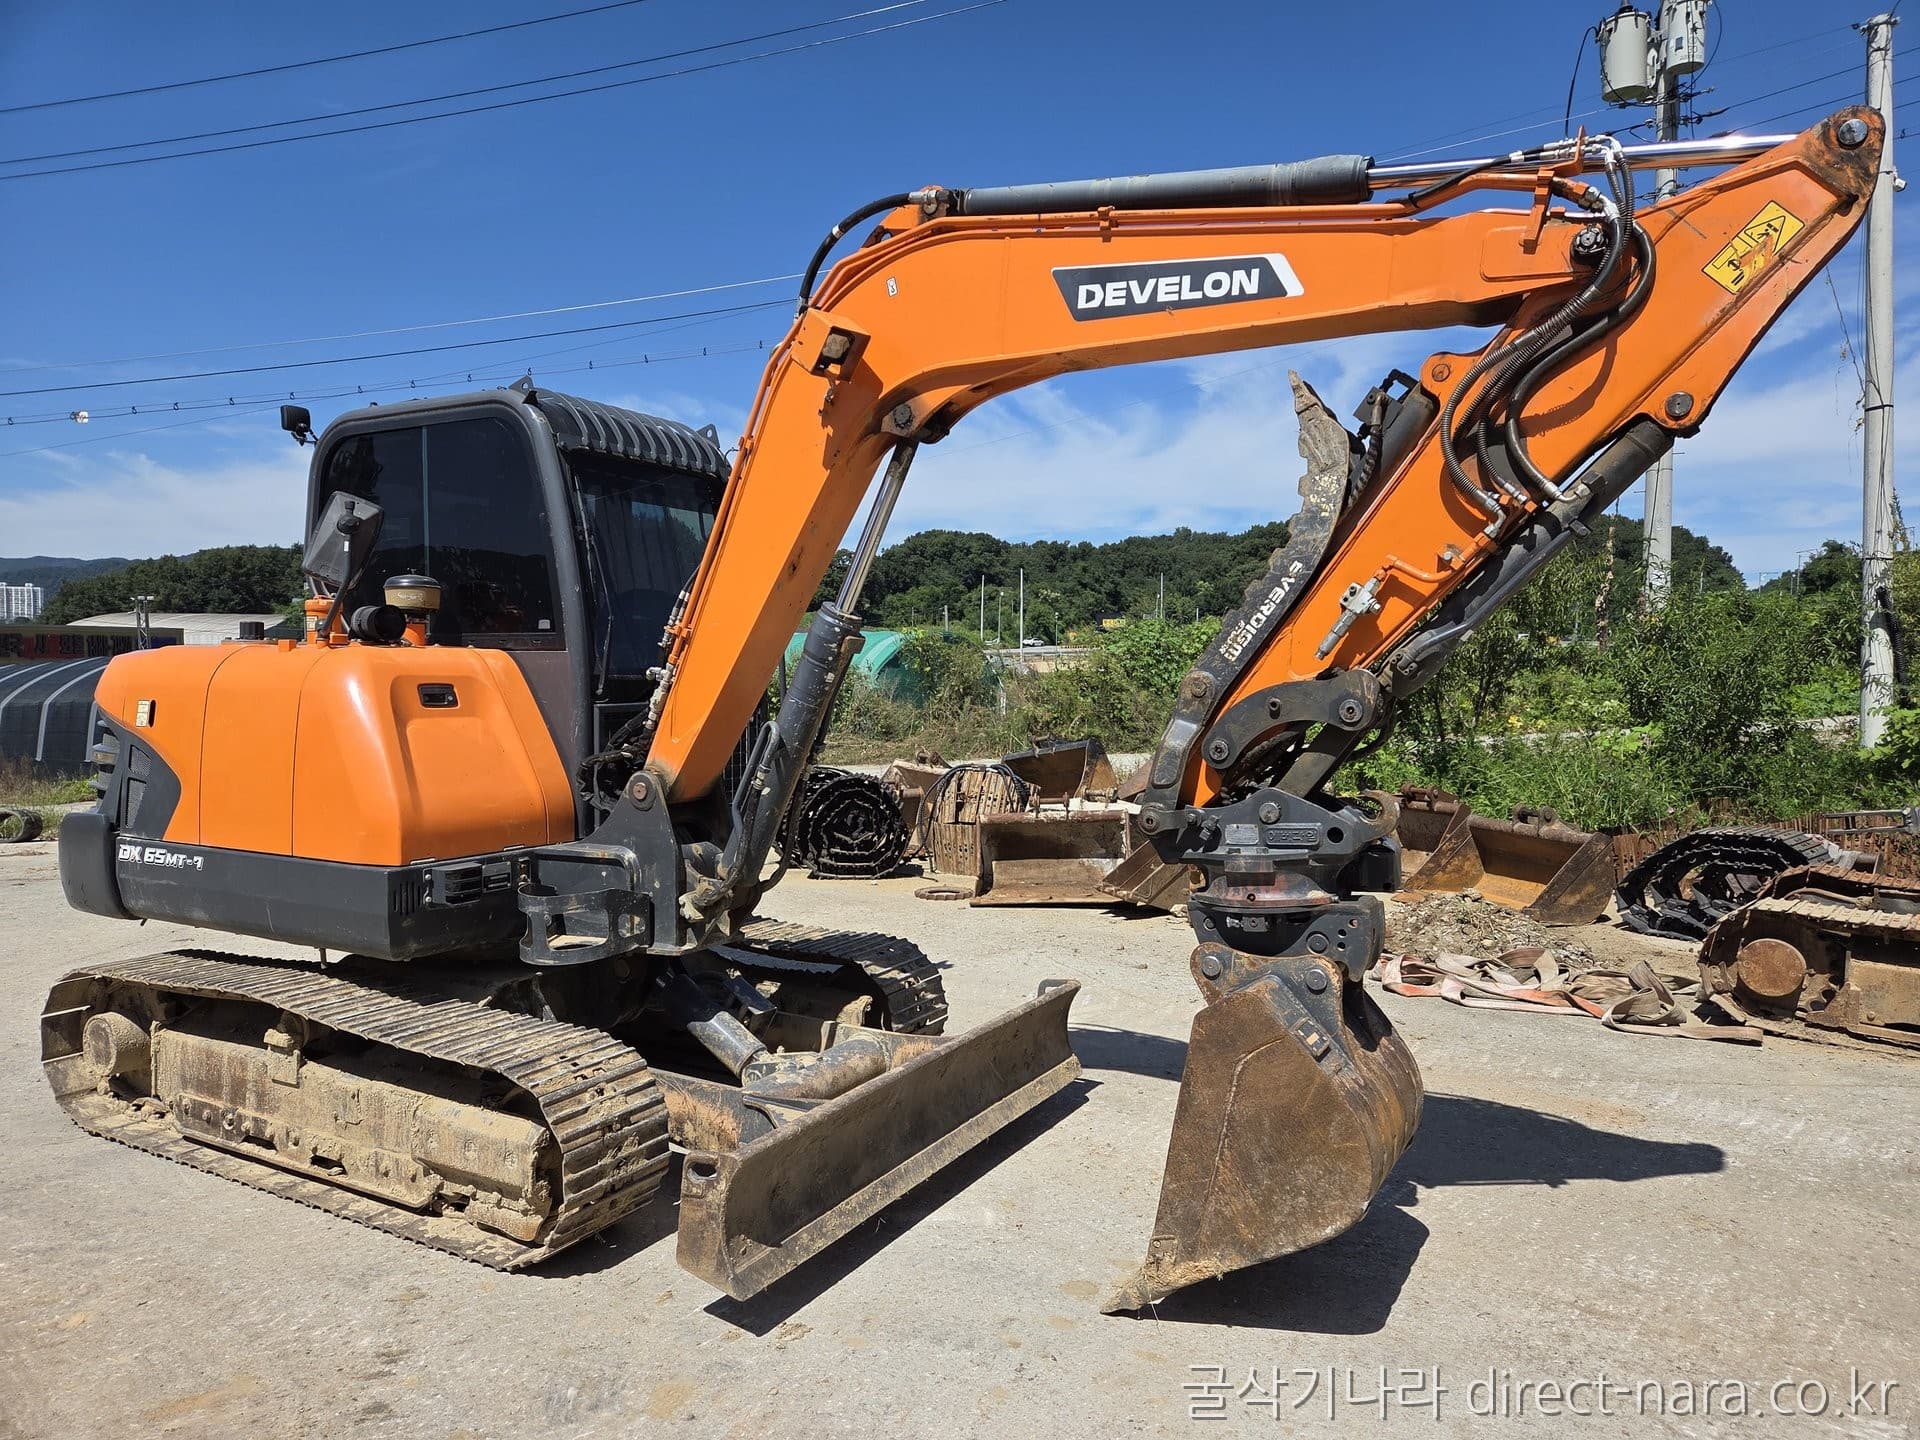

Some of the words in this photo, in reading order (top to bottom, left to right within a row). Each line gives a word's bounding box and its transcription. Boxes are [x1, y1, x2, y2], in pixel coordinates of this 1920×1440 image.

[1077, 268, 1260, 309] DEVELON
[1223, 560, 1303, 662] EVERDIGM
[118, 844, 143, 864] DX
